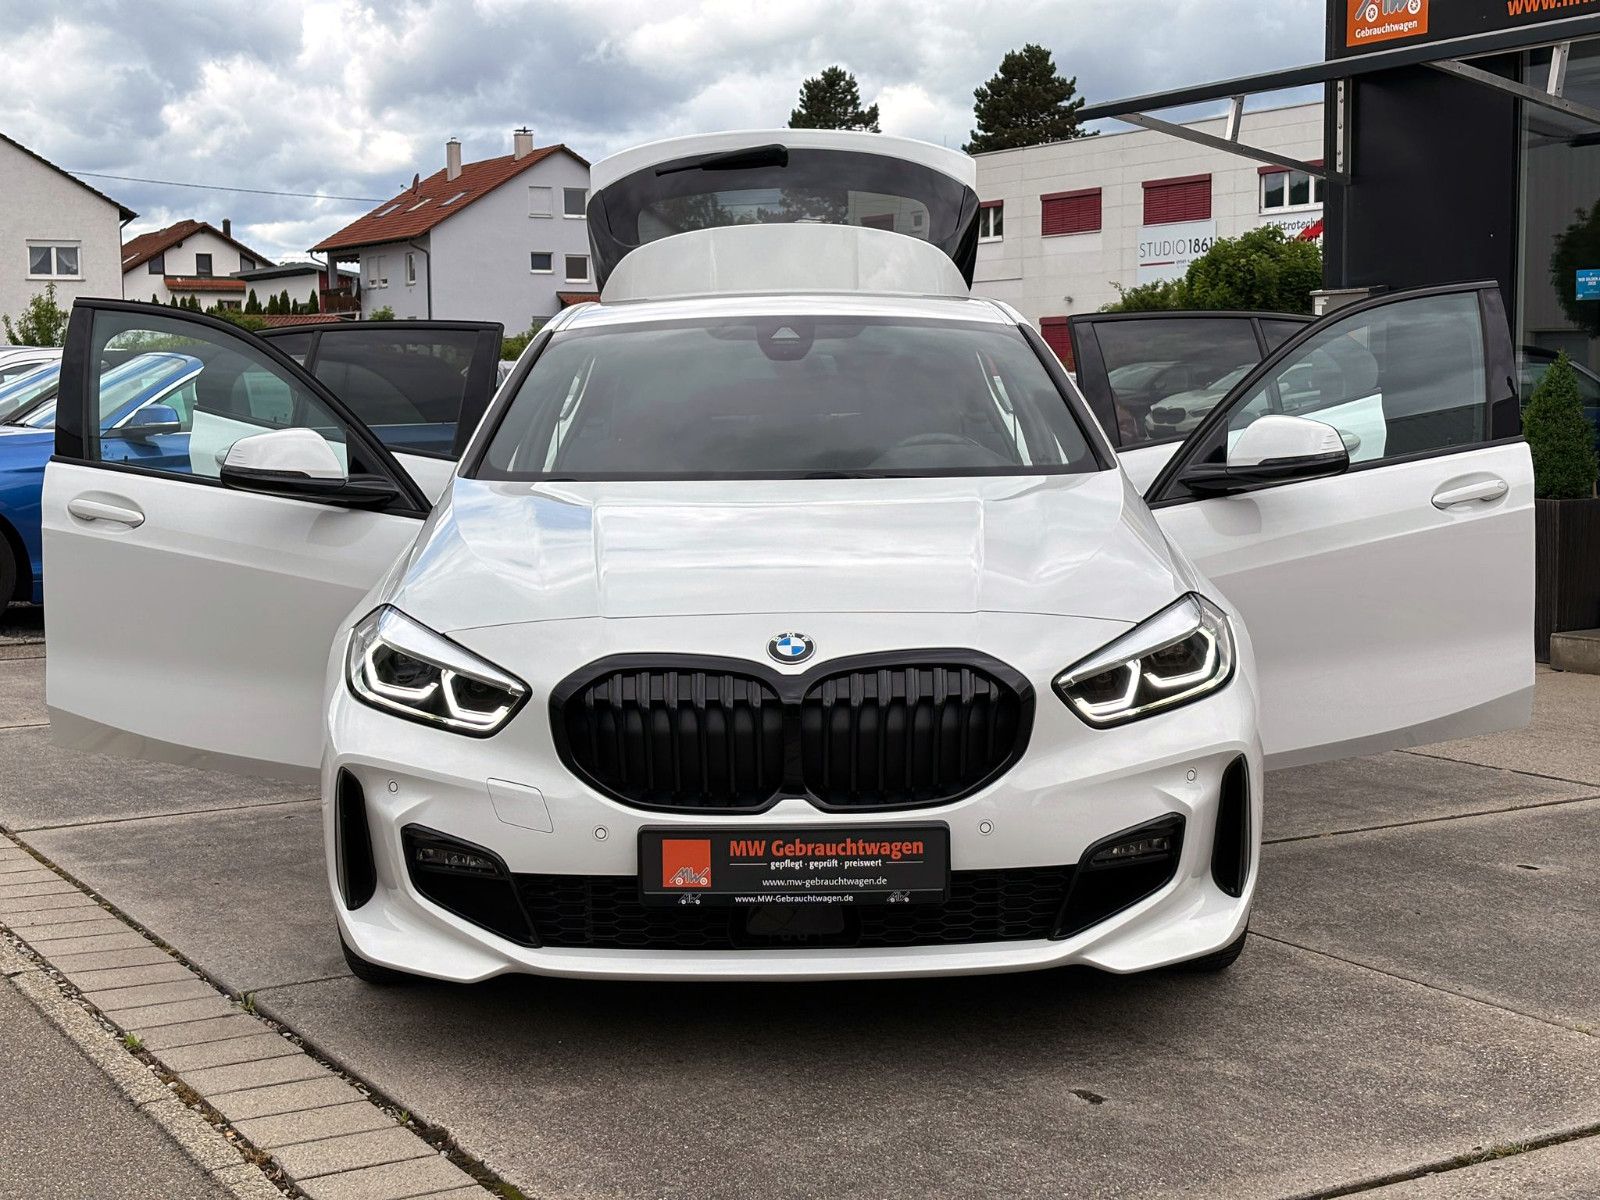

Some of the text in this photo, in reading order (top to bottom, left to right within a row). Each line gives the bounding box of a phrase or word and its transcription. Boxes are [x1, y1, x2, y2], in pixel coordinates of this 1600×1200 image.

[1355, 20, 1418, 38] Gebrauchtwagen
[1139, 237, 1213, 258] STUDIO 1861
[729, 837, 924, 860] MW Gebrauchtwagen
[770, 858, 882, 871] gepflegt geprüft preiswert
[762, 876, 888, 888] www.mw-gebrauchtwagen.de
[734, 894, 854, 904] www.MW-Gebrauchtwagen.de
